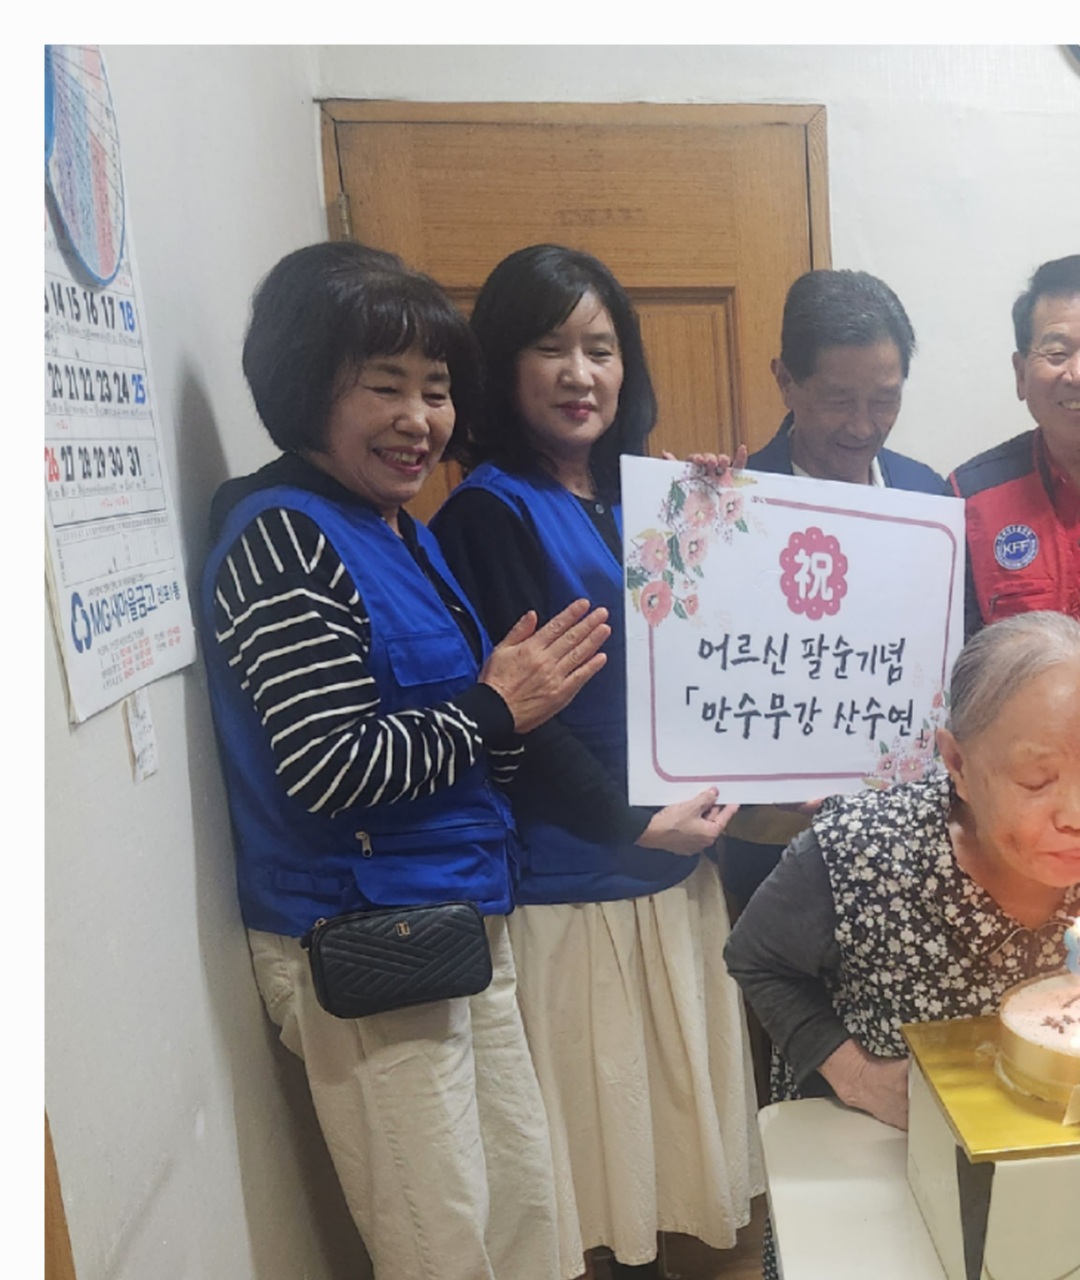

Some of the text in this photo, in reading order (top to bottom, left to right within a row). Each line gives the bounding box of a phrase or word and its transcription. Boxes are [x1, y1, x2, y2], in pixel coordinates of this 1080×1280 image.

[66, 287, 81, 322] 15
[83, 292, 98, 325] 16
[101, 296, 115, 330] 17
[119, 301, 135, 332] 18
[64, 364, 79, 400] 21
[79, 367, 95, 401] 22
[96, 369, 112, 402] 23
[113, 371, 129, 403] 24
[131, 374, 146, 404] 25
[78, 446, 92, 479] 28
[93, 446, 106, 478] 29
[108, 446, 124, 477] 30
[127, 445, 142, 477] 31
[1003, 540, 1030, 558] KFF
[794, 549, 833, 600] 祝
[698, 633, 905, 685] 어르신 팔순기념
[686, 687, 822, 739] 「만수무강
